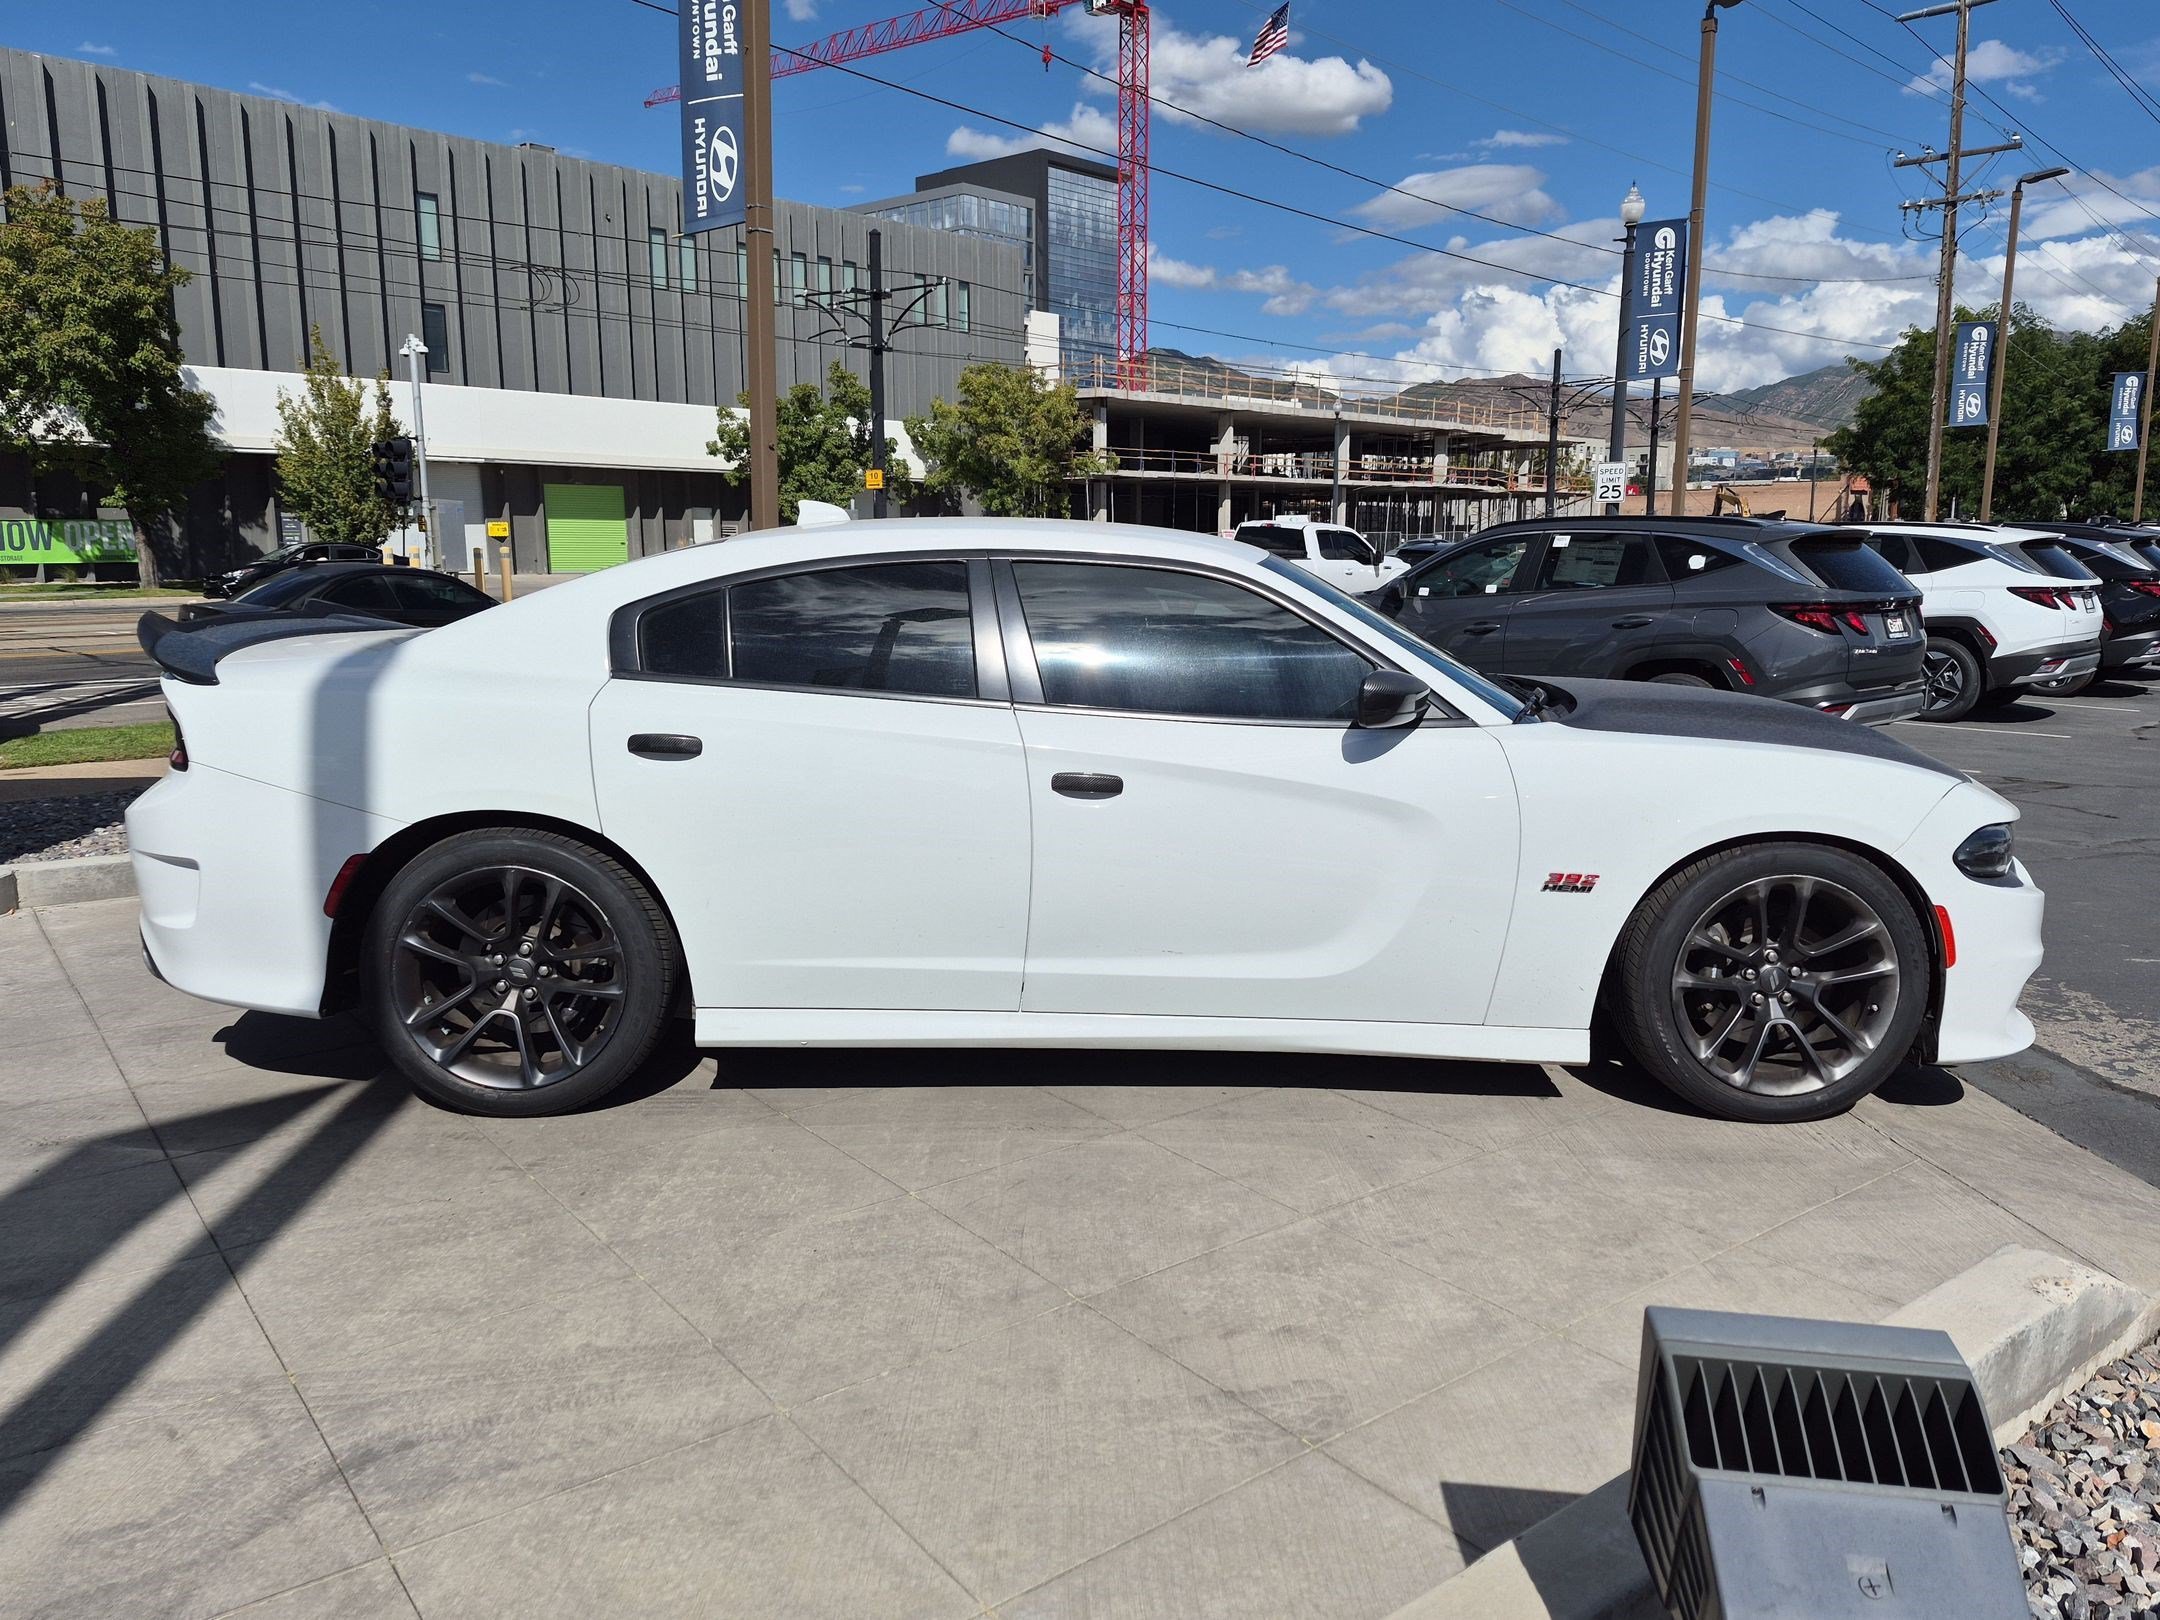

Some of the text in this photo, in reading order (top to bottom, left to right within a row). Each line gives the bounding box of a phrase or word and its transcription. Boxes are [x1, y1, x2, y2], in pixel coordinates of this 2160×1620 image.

[704, 0, 722, 81] undai
[723, 4, 738, 55] Garff
[694, 118, 707, 218] HYUNDAI
[1651, 251, 1665, 308] Hyundai
[1664, 250, 1675, 295] Ken Garff
[1638, 324, 1649, 373] HYUNDAI
[1967, 342, 1979, 379] Hyundai
[1957, 389, 1966, 422] HYUNDAI
[2122, 387, 2131, 415] Hyundai
[1599, 485, 1622, 499] 25
[64, 521, 136, 550] OPEN
[1540, 884, 1594, 893] HEMI
